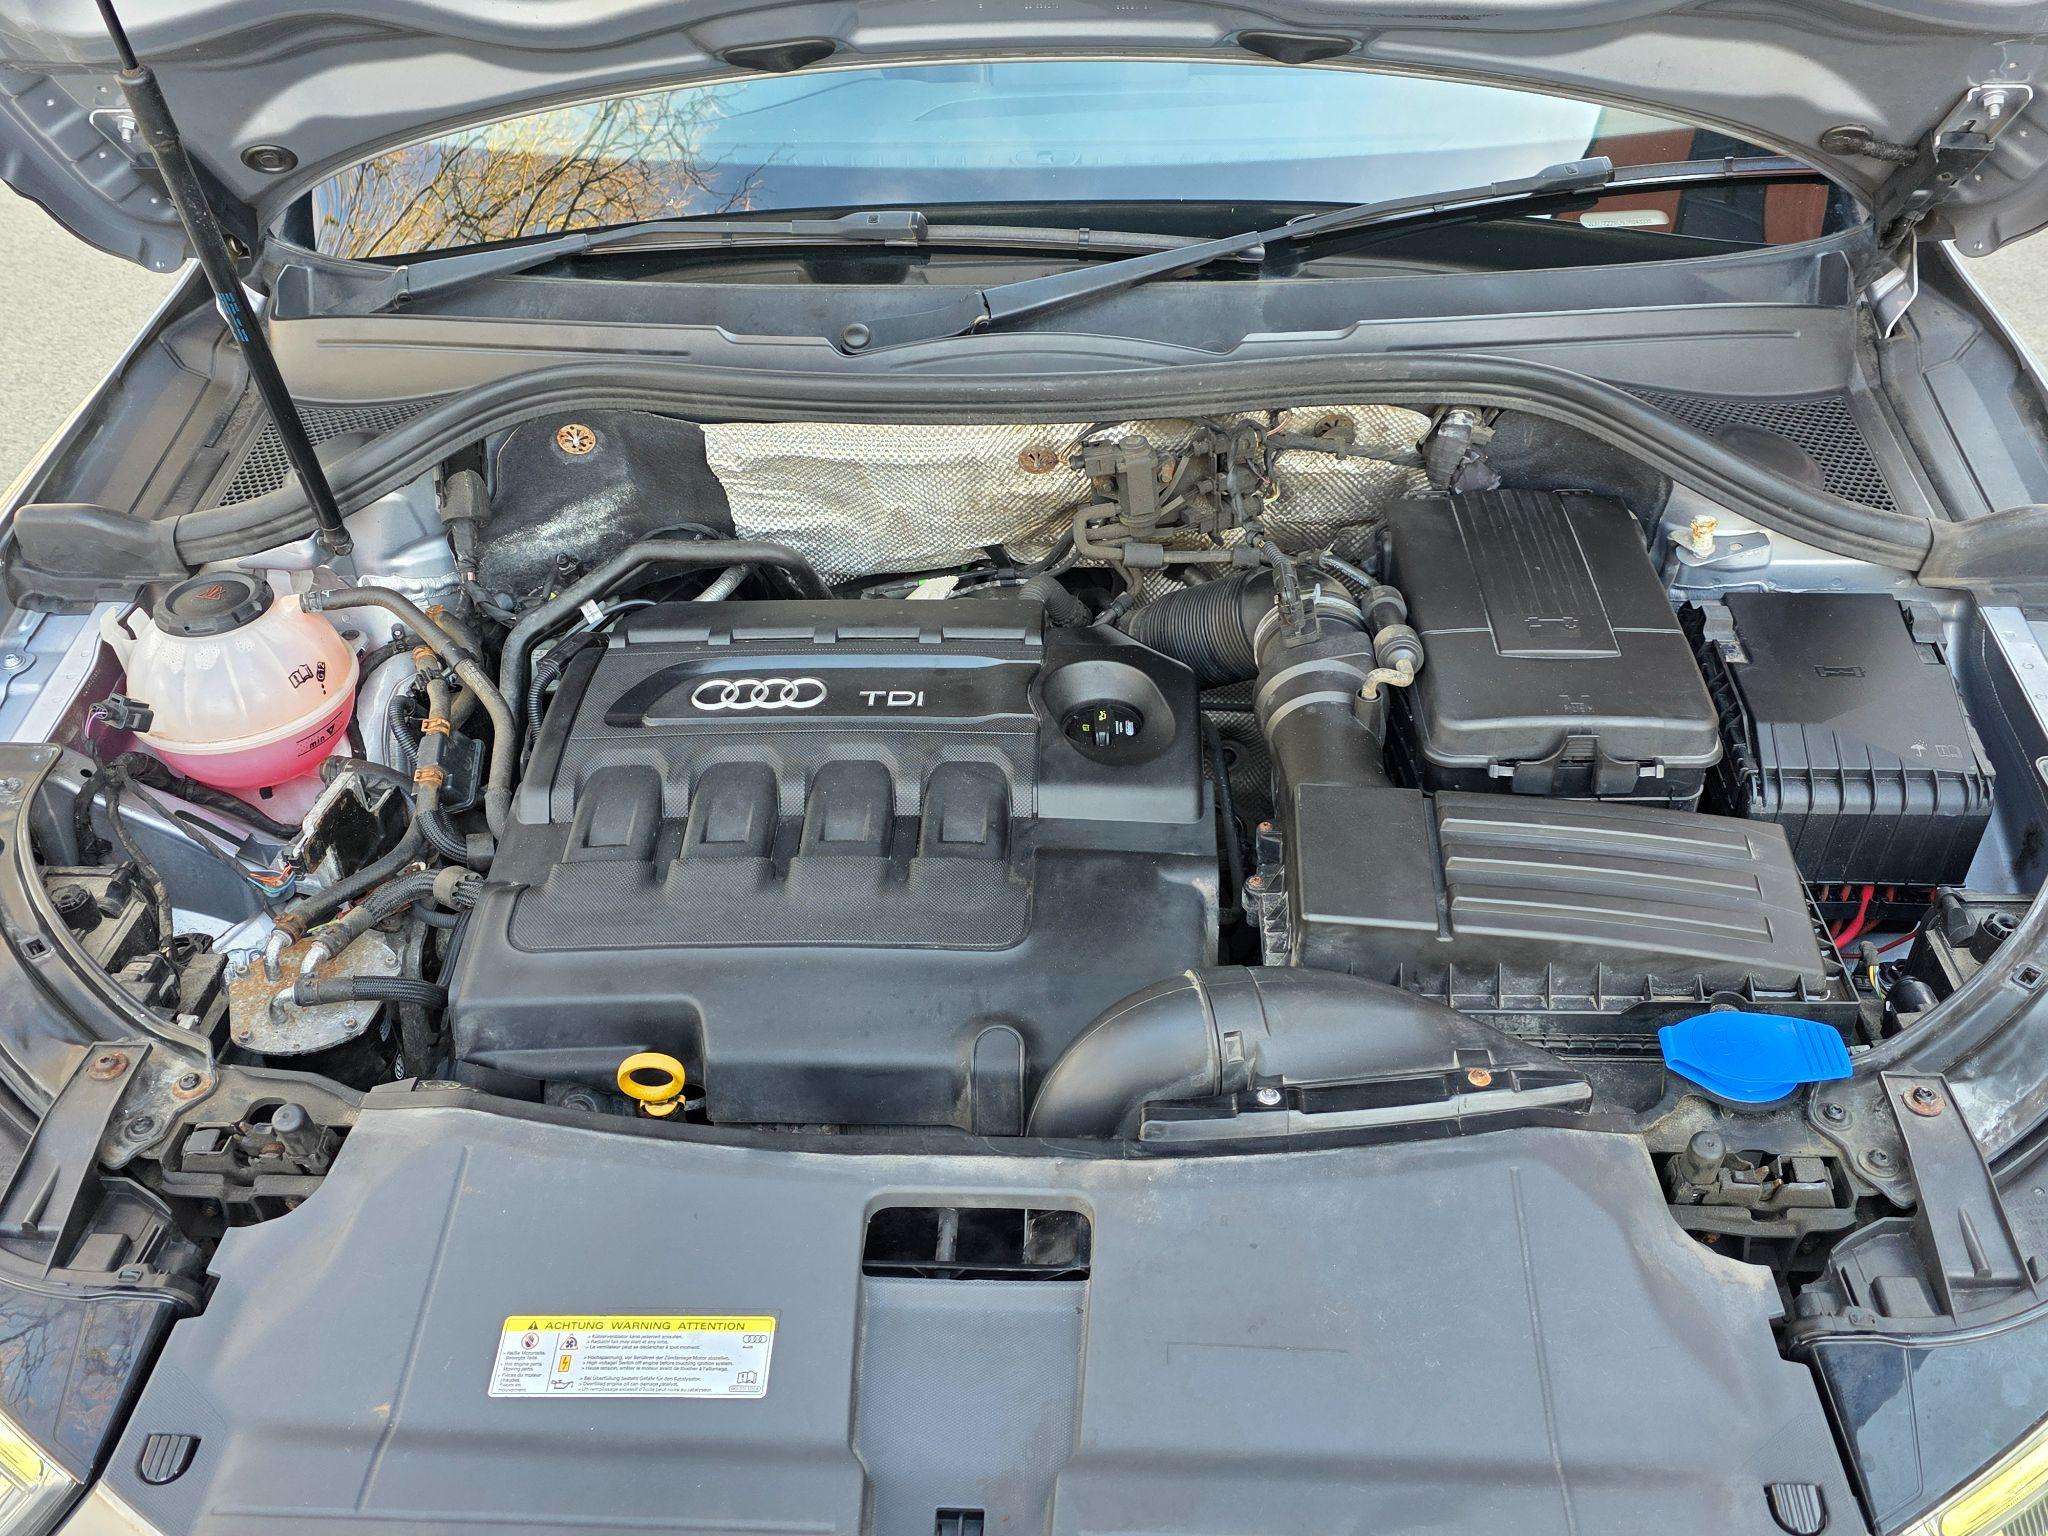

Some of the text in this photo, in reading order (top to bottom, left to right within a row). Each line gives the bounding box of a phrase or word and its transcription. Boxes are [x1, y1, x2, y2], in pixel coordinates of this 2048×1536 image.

[858, 690, 924, 707] TDI
[309, 735, 326, 750] min
[544, 1322, 746, 1330] ACHTUNG WARNING ATTENTION
